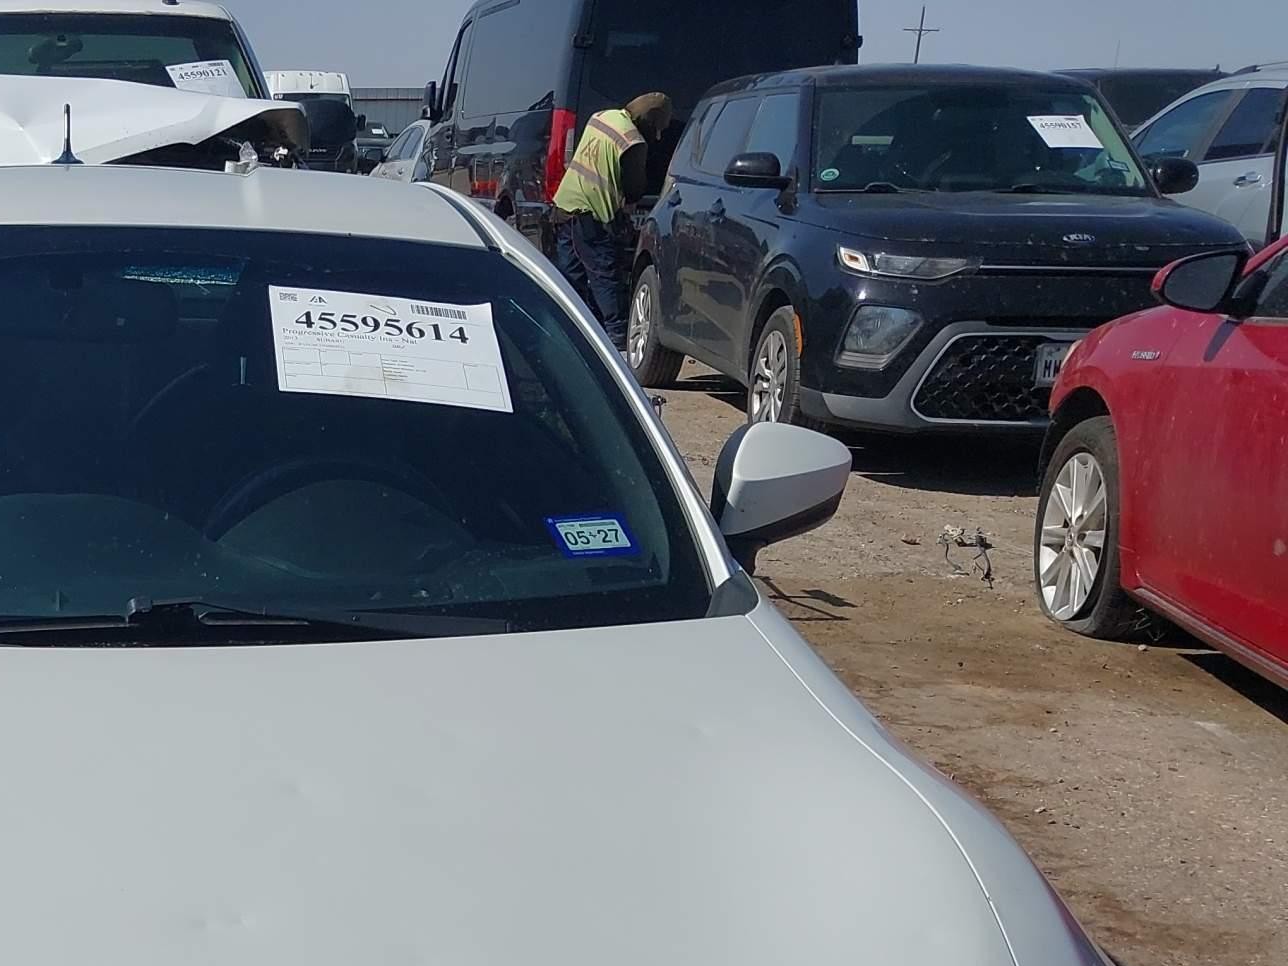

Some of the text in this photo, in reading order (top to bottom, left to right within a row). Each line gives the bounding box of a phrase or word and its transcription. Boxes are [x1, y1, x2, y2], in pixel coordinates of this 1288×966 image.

[282, 327, 335, 337] Progressive
[337, 331, 377, 342] Casualty
[295, 310, 469, 344] 45595614
[564, 528, 620, 546] 05 27
